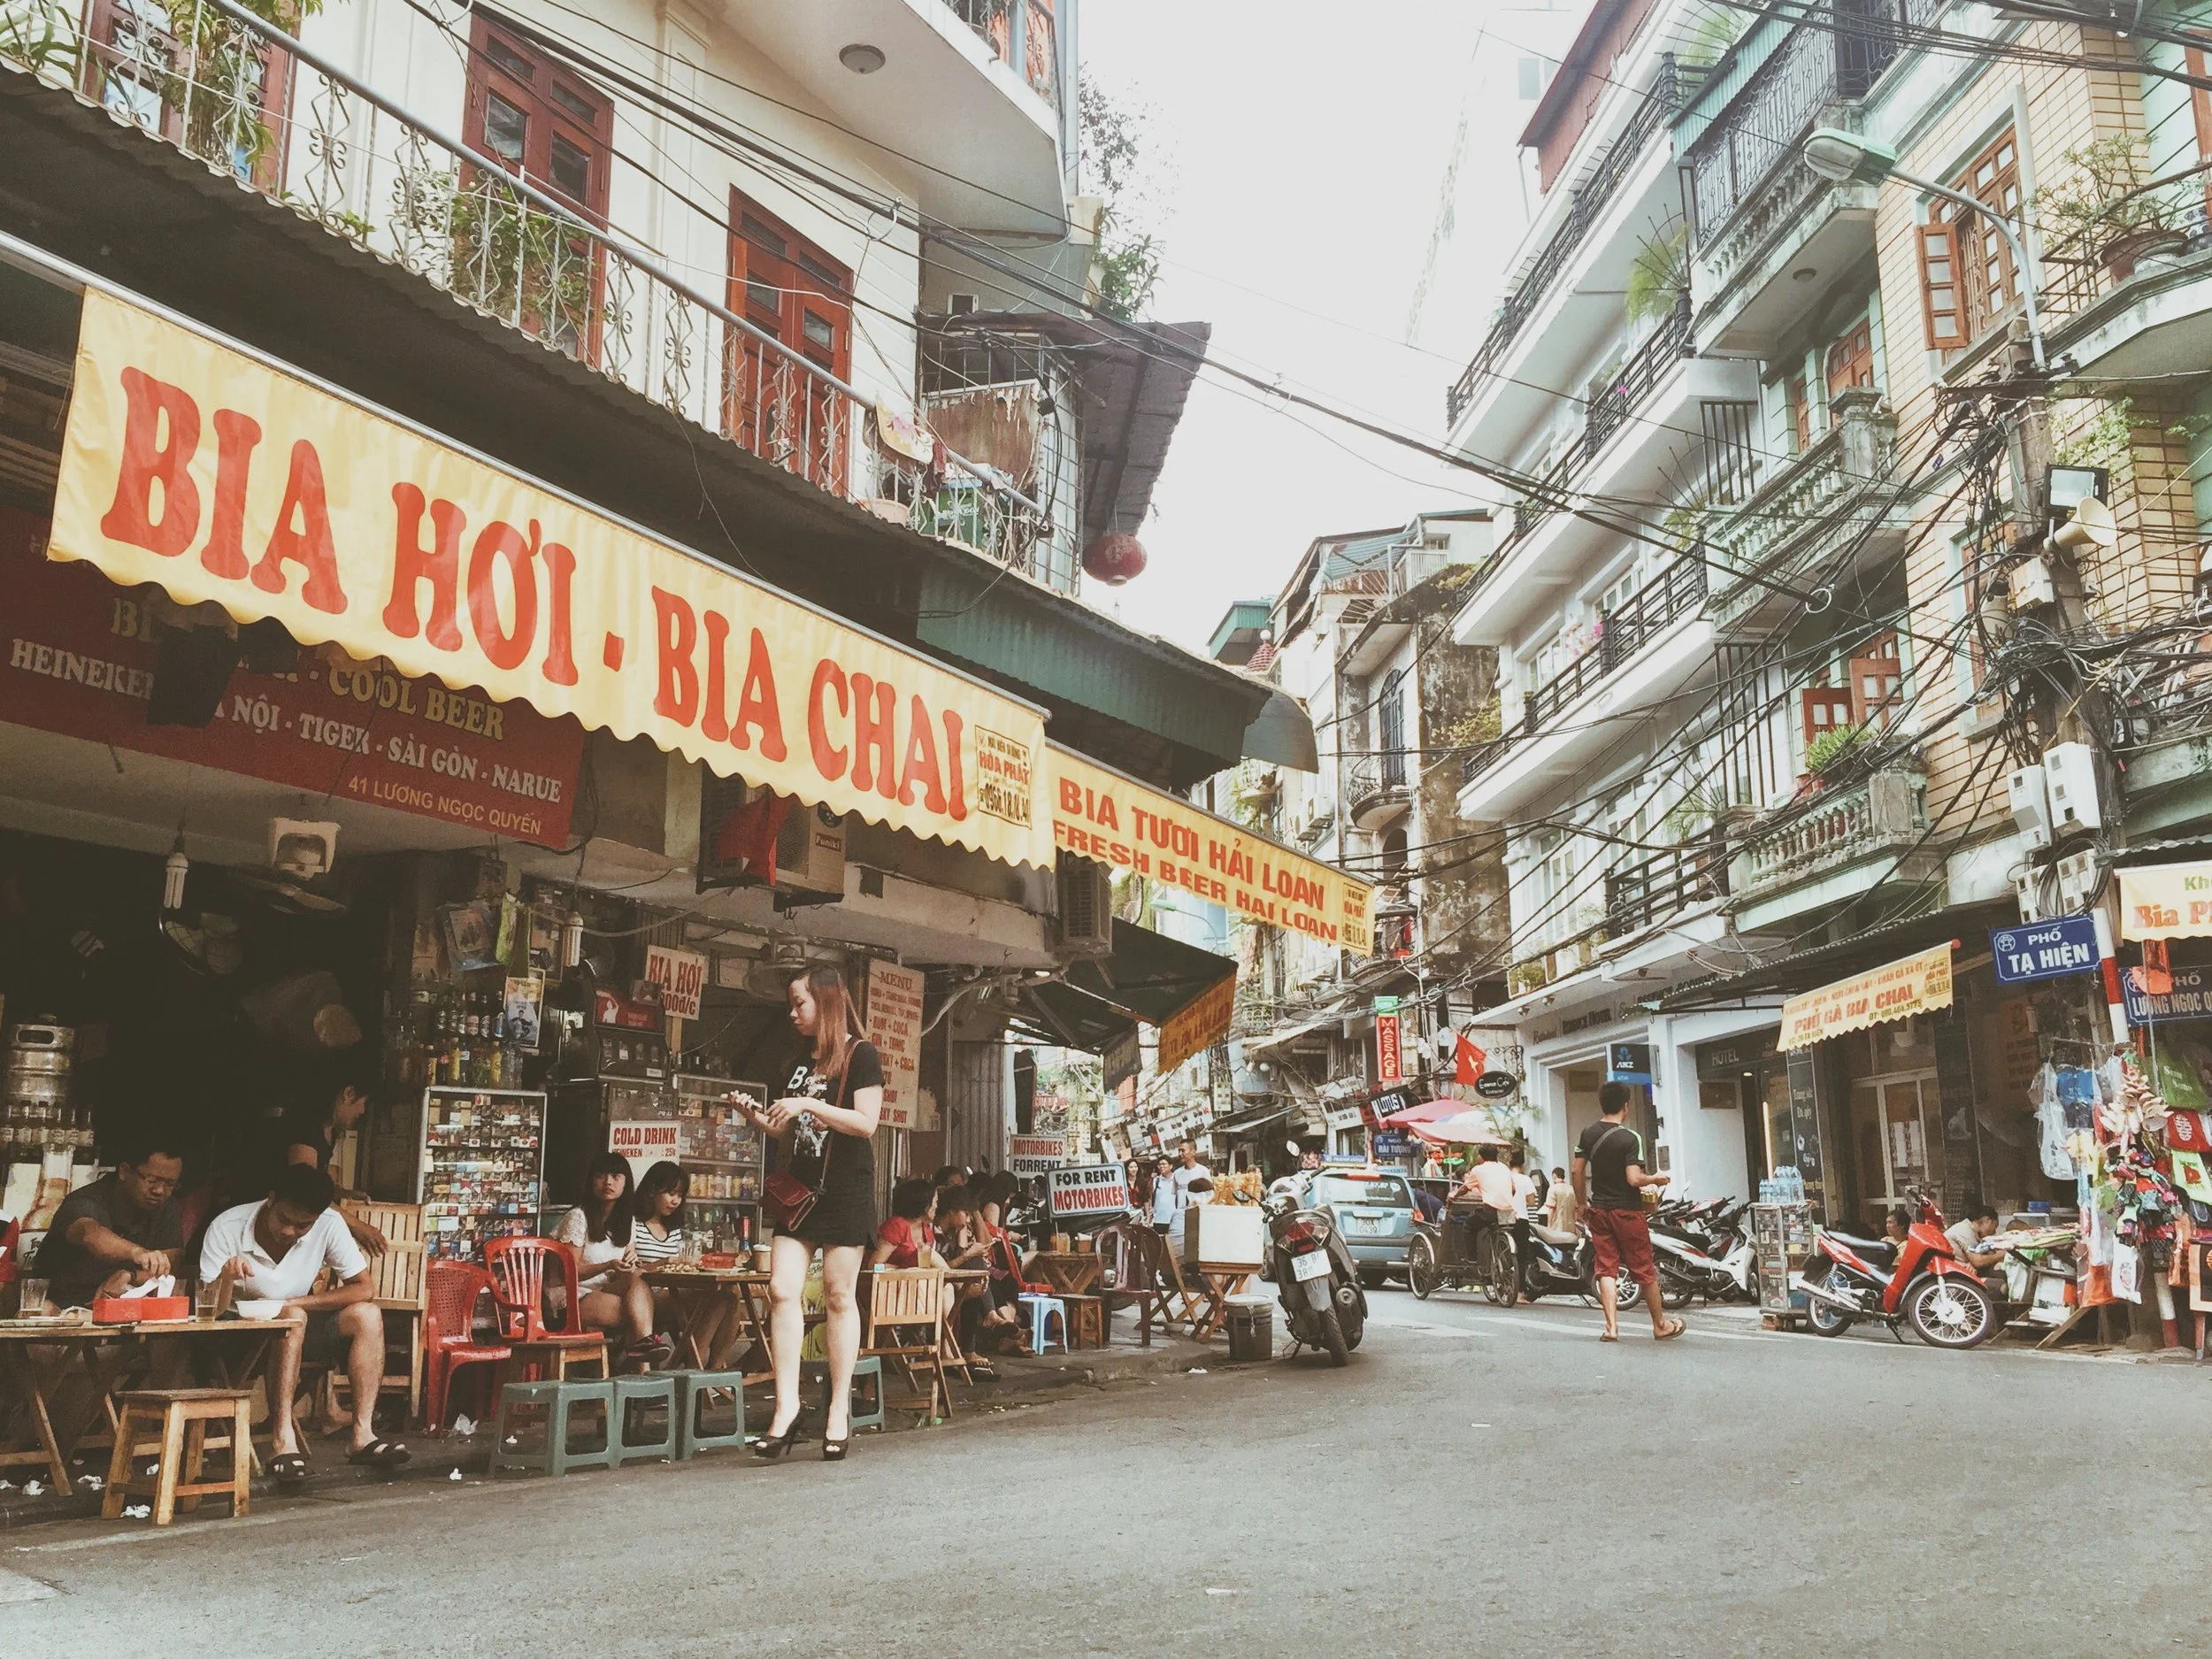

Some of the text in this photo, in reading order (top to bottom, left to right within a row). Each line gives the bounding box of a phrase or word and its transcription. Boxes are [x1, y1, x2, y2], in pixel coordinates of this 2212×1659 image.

[100, 365, 578, 686] BIA HƠI
[328, 665, 416, 715] COOL
[424, 687, 503, 741] BEER
[652, 585, 968, 821] BIA CHAI
[231, 693, 562, 803] NỘI TIGER SÀI GÒN NARUE
[349, 775, 367, 795] 41
[373, 780, 433, 809] LƯƠNG
[438, 797, 485, 823] NGỌC
[816, 835, 840, 849] Funiki
[1060, 777, 1119, 832] BIA
[1131, 805, 1199, 863] TƯƠI
[1210, 838, 1253, 885] HẢI
[1263, 863, 1325, 911] LOAN
[1053, 819, 1150, 874] FRESH
[1160, 860, 1227, 902] BEER
[1236, 889, 1274, 920] HAI
[1282, 907, 1337, 941] LOAN
[2185, 876, 2212, 891] Kh
[2134, 904, 2179, 928] Bia
[2027, 926, 2062, 946] PHỐ
[2008, 941, 2091, 974] TẠ HIỆN
[649, 955, 672, 991] BIA
[879, 971, 912, 991] MENU
[2170, 970, 2201, 987] HỐ
[1876, 984, 1914, 1010] CHAI
[1381, 1018, 1395, 1077] MASSAGE
[1712, 1049, 1740, 1066] HOTEL
[1380, 1094, 1400, 1113] LOTUS
[613, 1126, 677, 1145] COLD DRINK
[1013, 1139, 1064, 1156] MOTORBIKES
[1056, 1169, 1116, 1186] FOR RENT
[1053, 1186, 1125, 1211] MOTORBIKES
